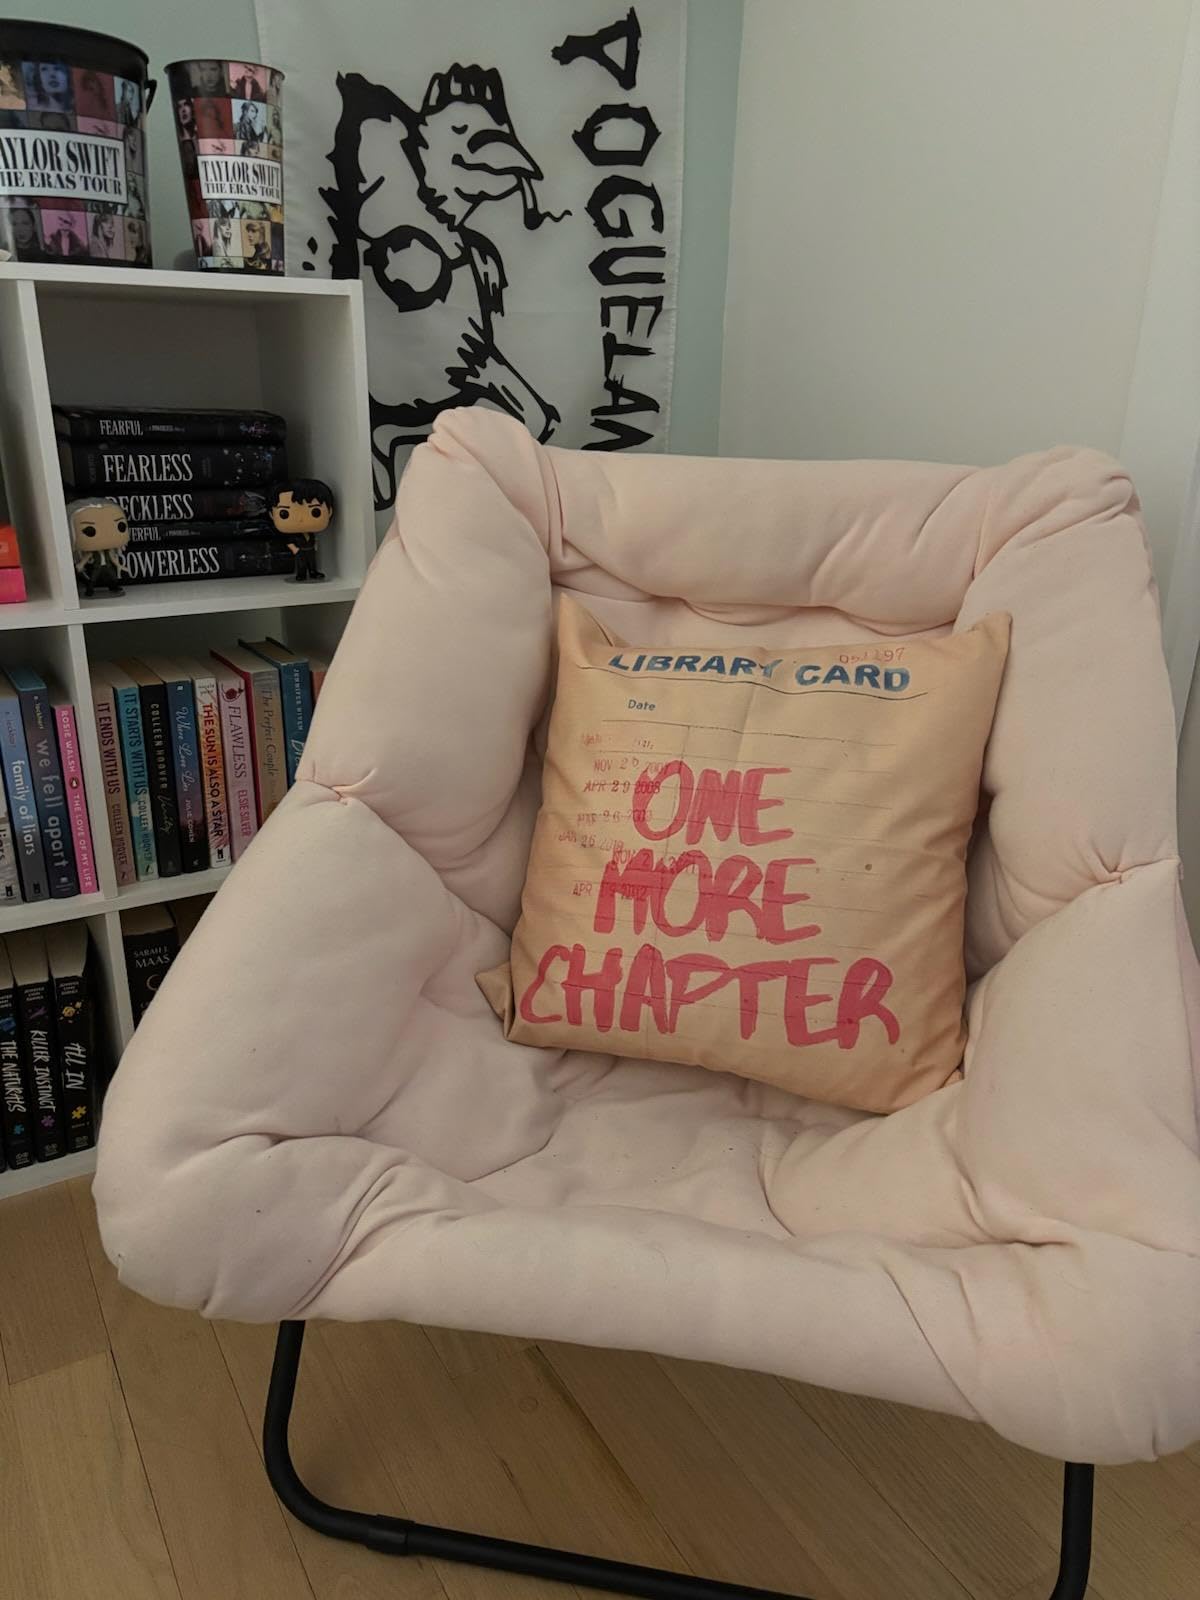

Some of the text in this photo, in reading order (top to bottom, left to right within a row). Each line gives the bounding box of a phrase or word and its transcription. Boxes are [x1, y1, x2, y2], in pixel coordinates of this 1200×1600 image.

[67, 140, 120, 179] SWIFT
[201, 160, 280, 188] TAYLOR SWIFT
[29, 172, 77, 190] ERAS
[80, 176, 122, 196] TOUR
[205, 182, 280, 198] THE ERAS TOUR
[100, 420, 143, 436] FEARFUL
[103, 453, 193, 482] FEARLESS
[607, 653, 911, 692] LIBRARY CARD
[97, 702, 112, 713] IT
[123, 693, 137, 705] IT
[627, 698, 657, 713] Date
[100, 713, 115, 744] ENDS
[125, 706, 143, 748] STARTS
[150, 703, 165, 747] COLLEEN
[202, 703, 215, 727] THE
[60, 710, 76, 773] ROSIE WALSH
[203, 729, 217, 756] SUN
[228, 705, 248, 779] FLAWLESS
[104, 746, 119, 780] WITH
[130, 750, 147, 780] WITH
[154, 751, 169, 790] HOOVER
[205, 757, 218, 769] IS
[41, 774, 64, 808] fell
[108, 780, 121, 795] US
[134, 780, 147, 796] US
[208, 768, 222, 798] ALSO
[583, 780, 607, 793] APR
[11, 759, 37, 856] family of liars
[138, 799, 149, 829] COLLEEN
[211, 800, 222, 811] A
[237, 789, 249, 812] ELSIE
[632, 759, 794, 846] ONE
[112, 803, 123, 835] COLLEEN
[211, 809, 225, 838] STAR
[44, 815, 69, 868] apart
[72, 794, 93, 887] THE LOVE OF MY LIFE
[573, 882, 593, 896] APR
[593, 848, 821, 943] MORE
[135, 954, 171, 969] MAAS
[519, 943, 900, 1050] CHAPTER
[1, 1039, 27, 1113] THE NATURALS
[30, 1030, 56, 1112] KILLER INSTINCT
[65, 1068, 87, 1091] IN
